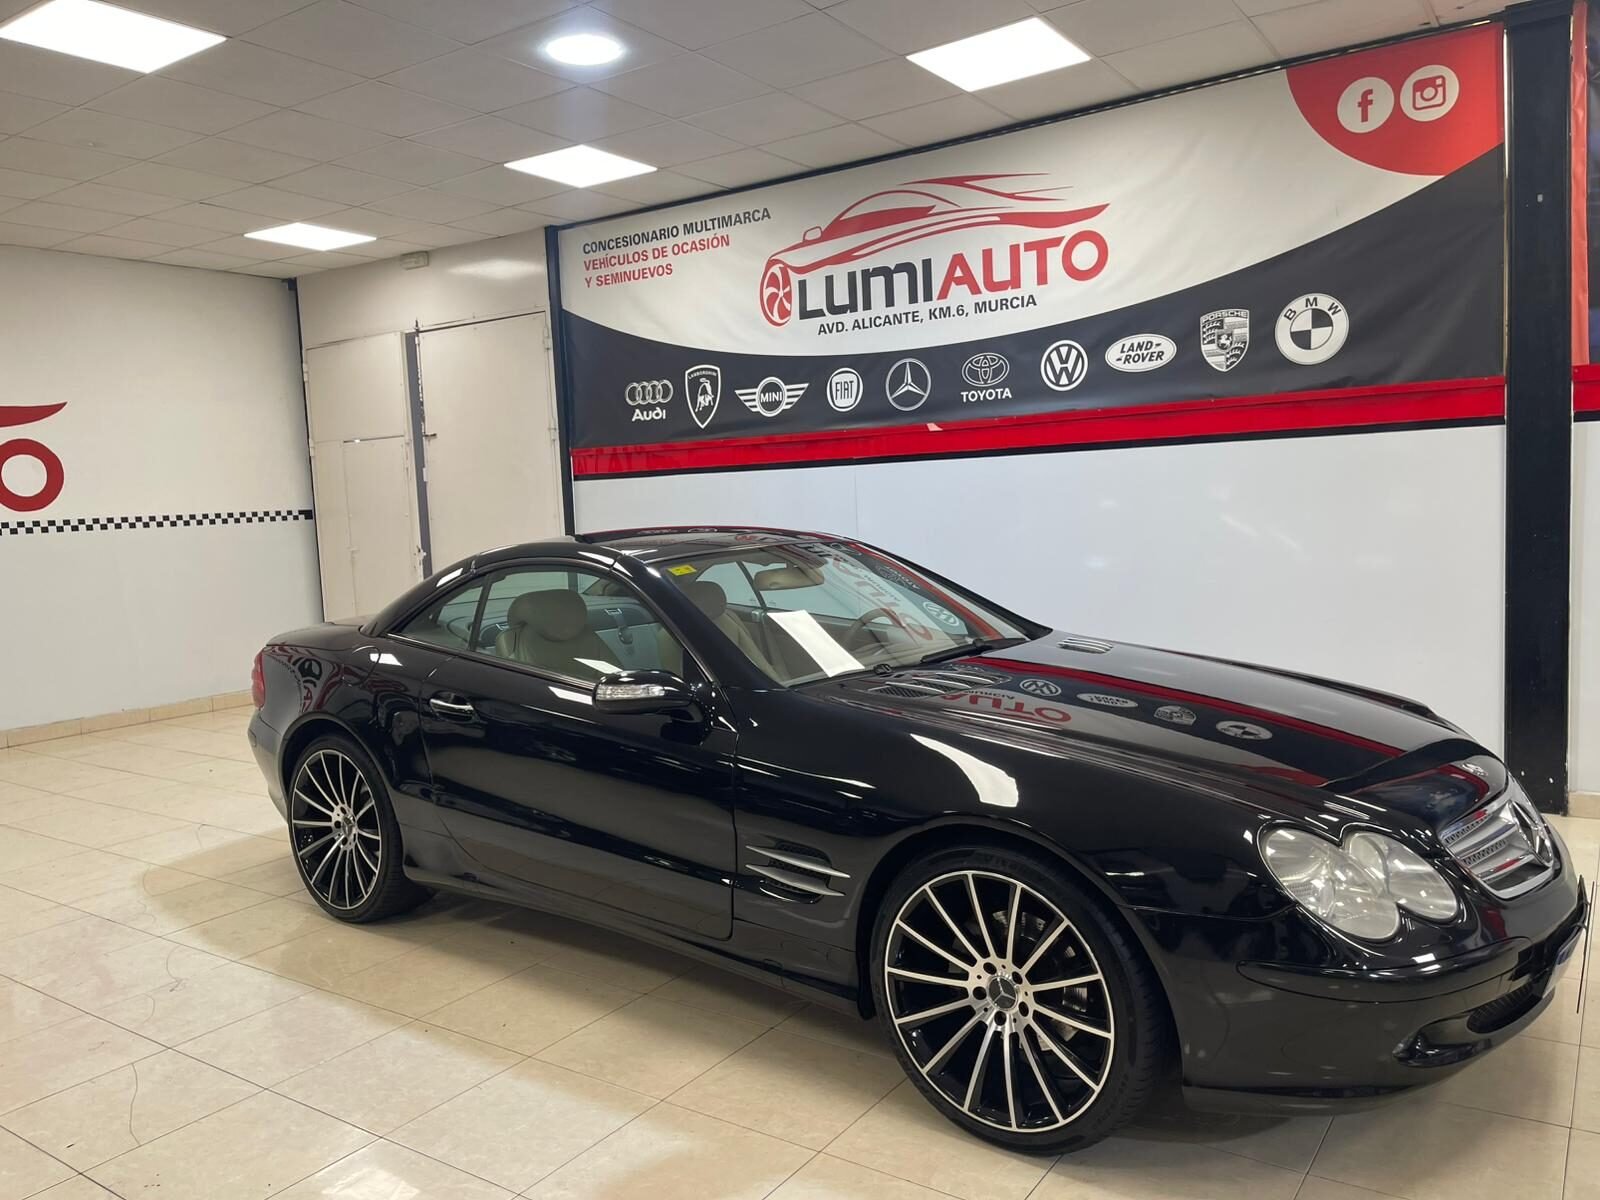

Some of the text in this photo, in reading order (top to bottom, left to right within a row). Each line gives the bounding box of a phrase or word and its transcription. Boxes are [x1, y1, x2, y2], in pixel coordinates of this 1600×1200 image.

[583, 207, 772, 254] CONCESIONARIO MULTIMARCA
[583, 233, 730, 272] VEHÍCULOS DE OCASIÓN
[585, 263, 673, 288] Y SEMINUEVOS
[817, 293, 1038, 336] AVD. ALICANTE, KM.6, MURCIA
[1202, 310, 1248, 323] PORSCHE
[1283, 296, 1343, 322] BMW
[760, 391, 783, 404] MINI
[835, 380, 854, 401] FIAT
[961, 387, 1012, 403] TOYOTA
[631, 407, 667, 422] Audi
